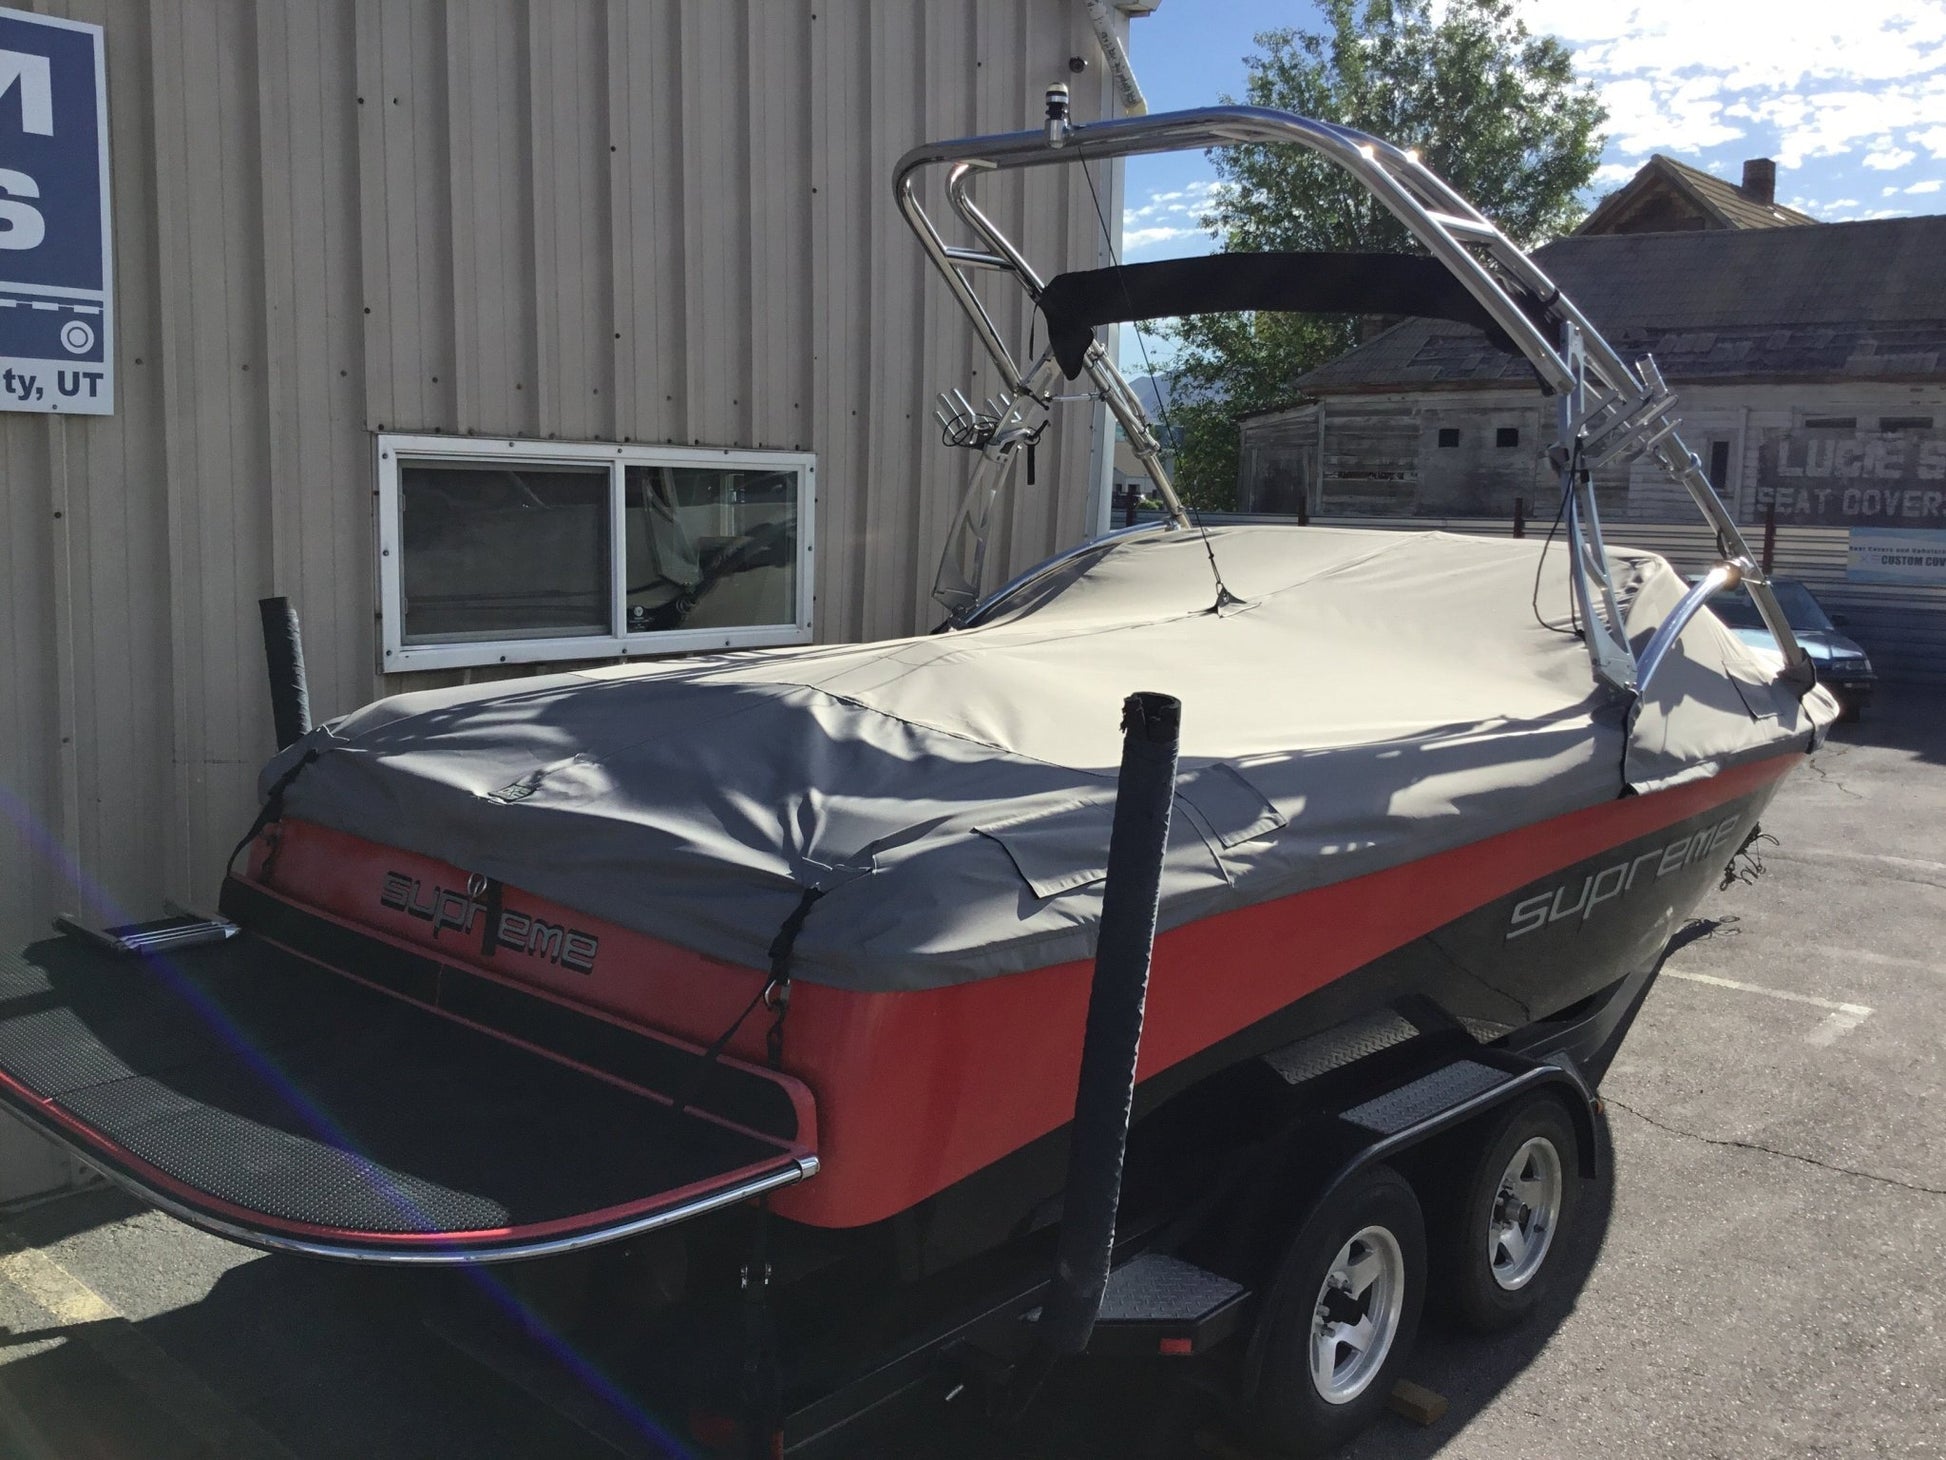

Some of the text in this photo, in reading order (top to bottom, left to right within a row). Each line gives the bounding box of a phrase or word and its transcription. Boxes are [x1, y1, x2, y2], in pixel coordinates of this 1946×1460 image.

[57, 370, 104, 398] UT
[1757, 486, 1946, 518] SEAT COVER
[1881, 554, 1924, 566] CUSTOM
